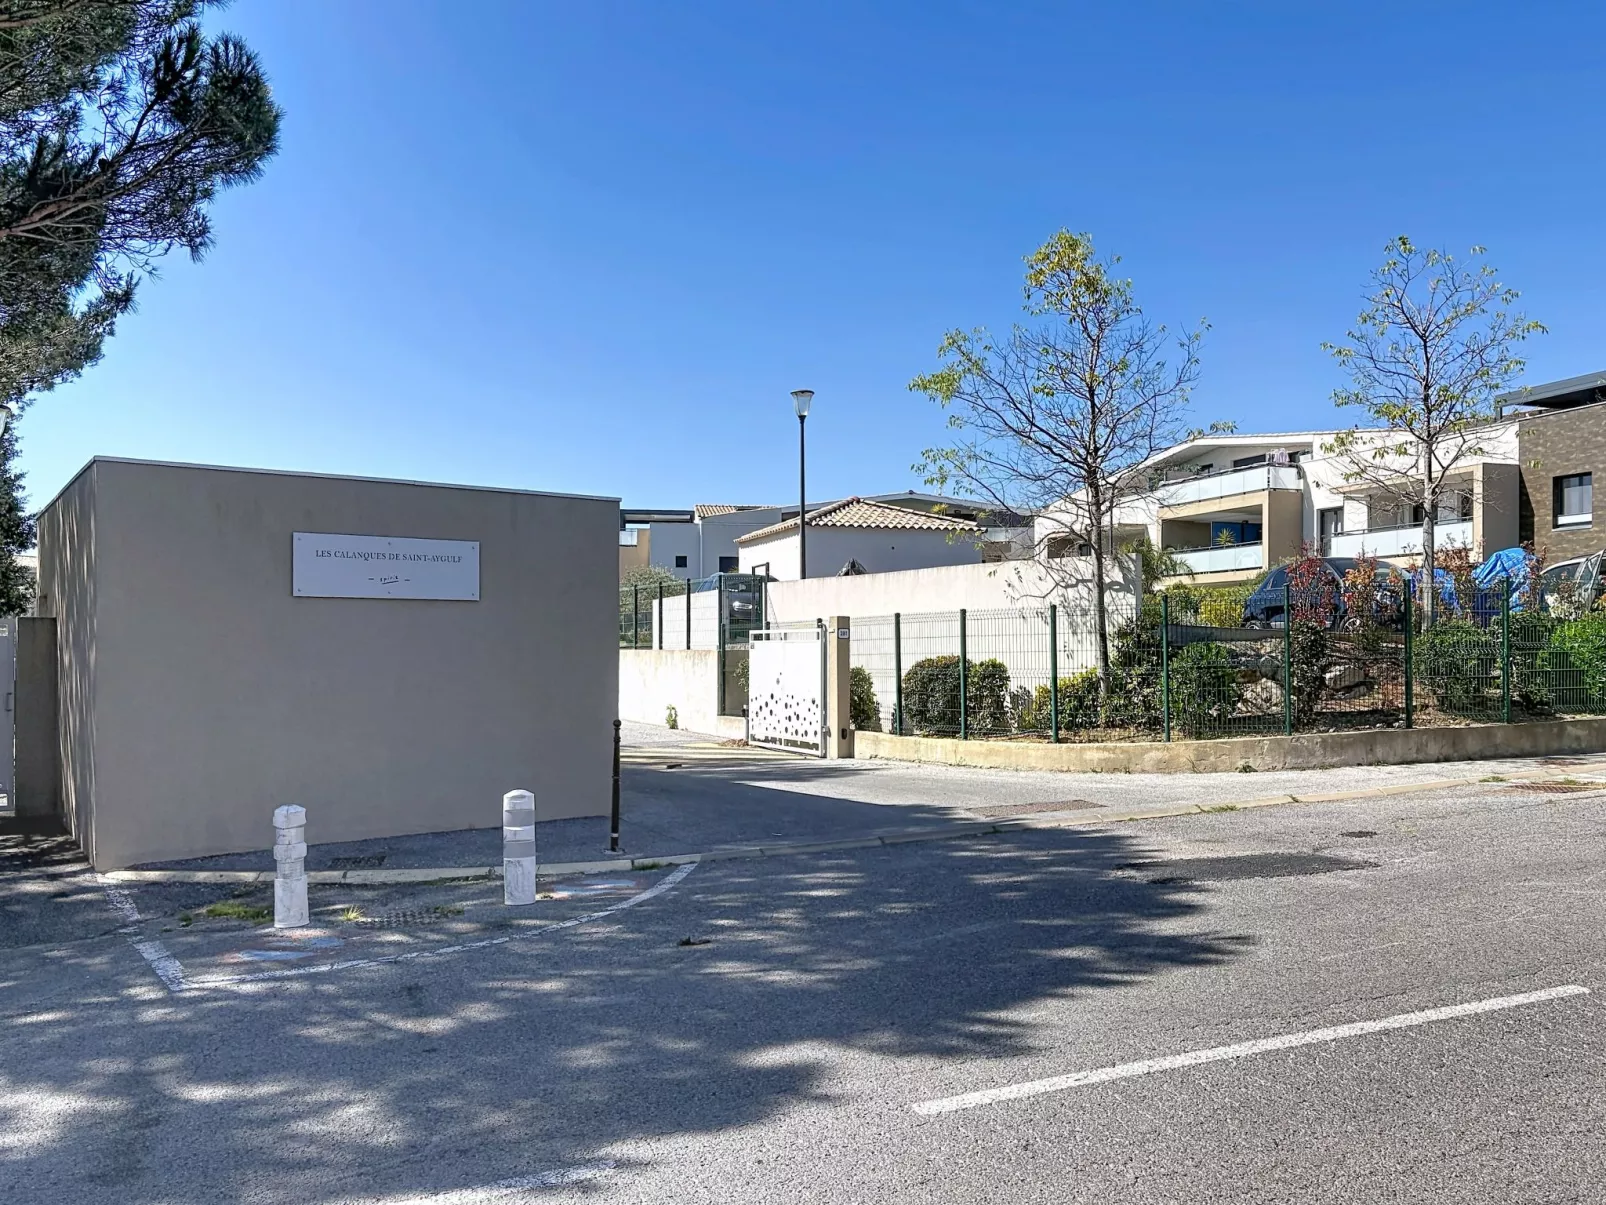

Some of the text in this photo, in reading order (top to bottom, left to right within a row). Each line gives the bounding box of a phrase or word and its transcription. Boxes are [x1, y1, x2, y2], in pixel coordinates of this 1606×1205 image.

[315, 549, 463, 563] LES CALANQUES DE SAINT-AYGULF
